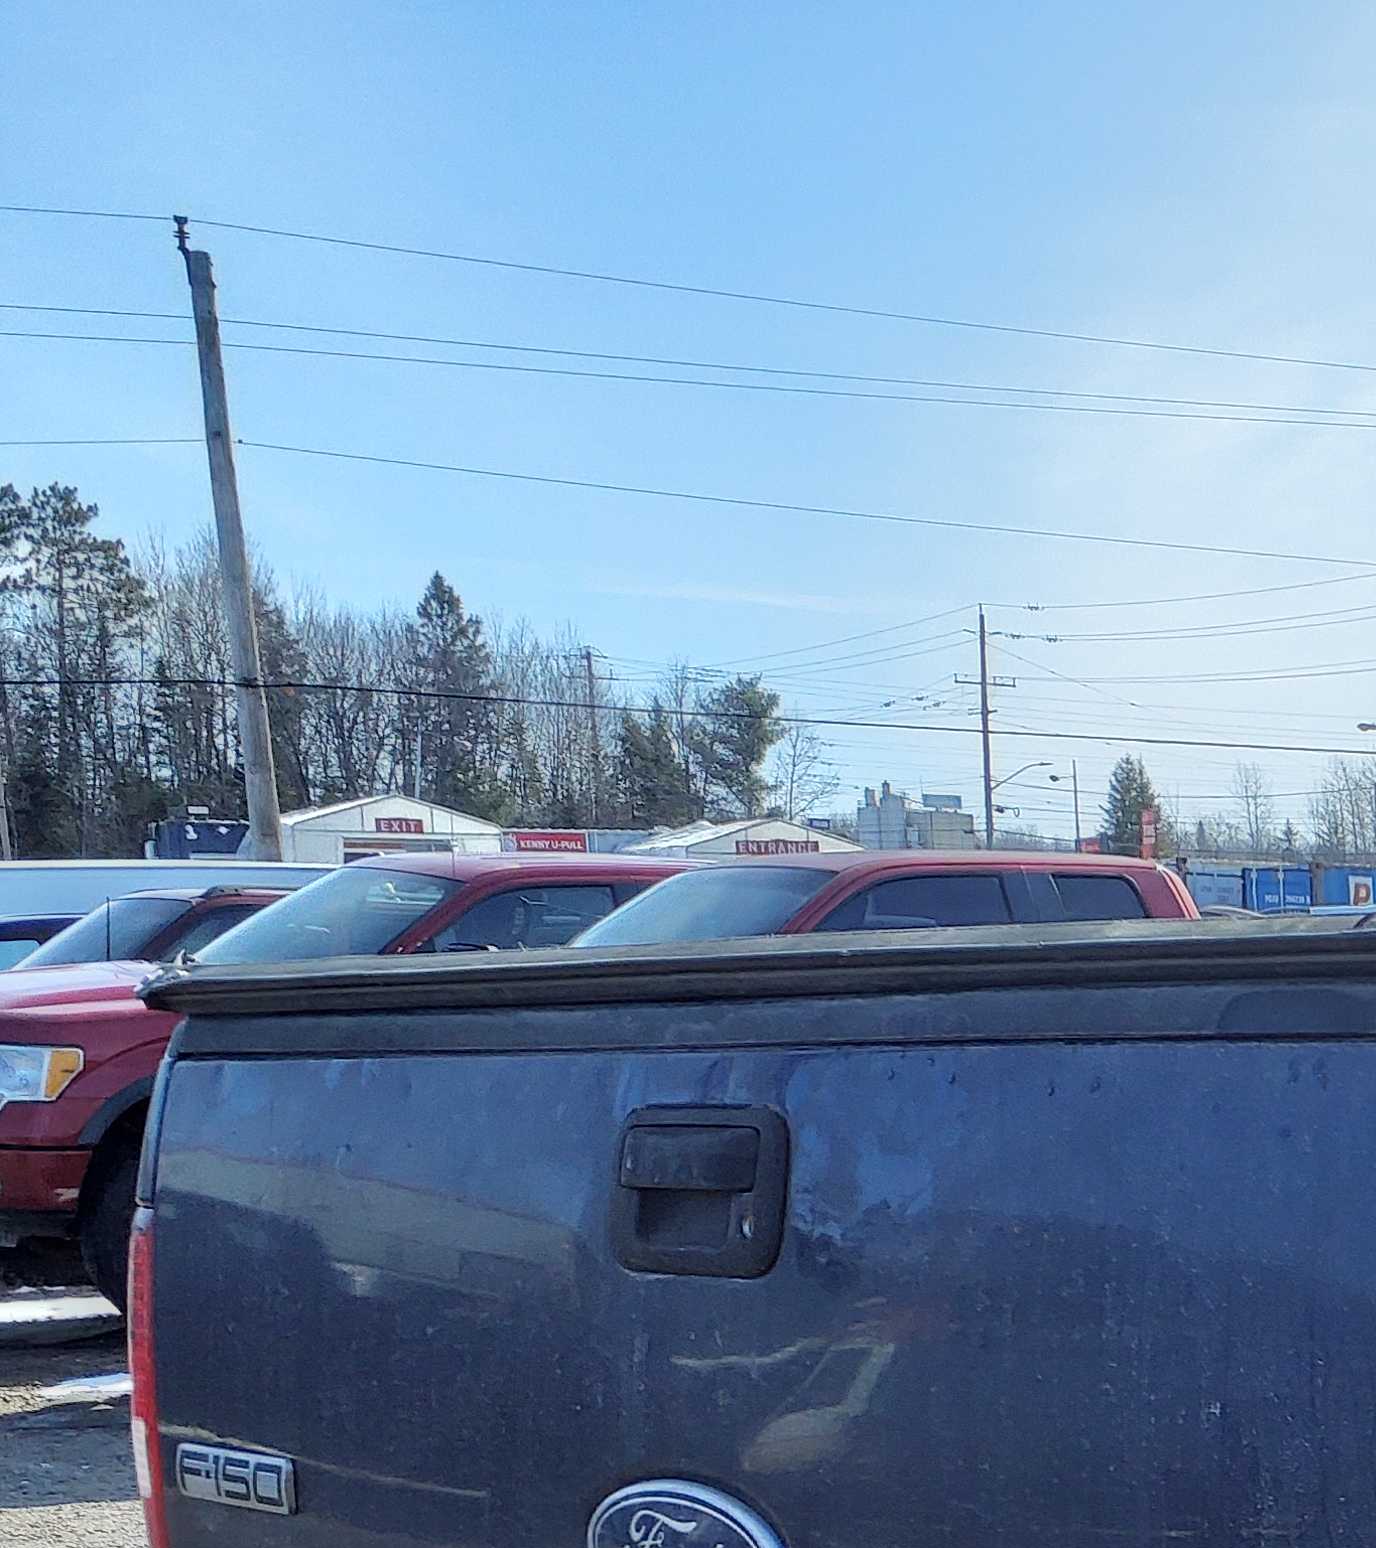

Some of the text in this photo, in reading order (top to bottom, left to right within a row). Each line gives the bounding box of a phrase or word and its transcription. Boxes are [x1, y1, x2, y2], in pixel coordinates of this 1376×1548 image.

[379, 819, 418, 833] EXIT
[519, 839, 583, 850] KENNY U-PULL
